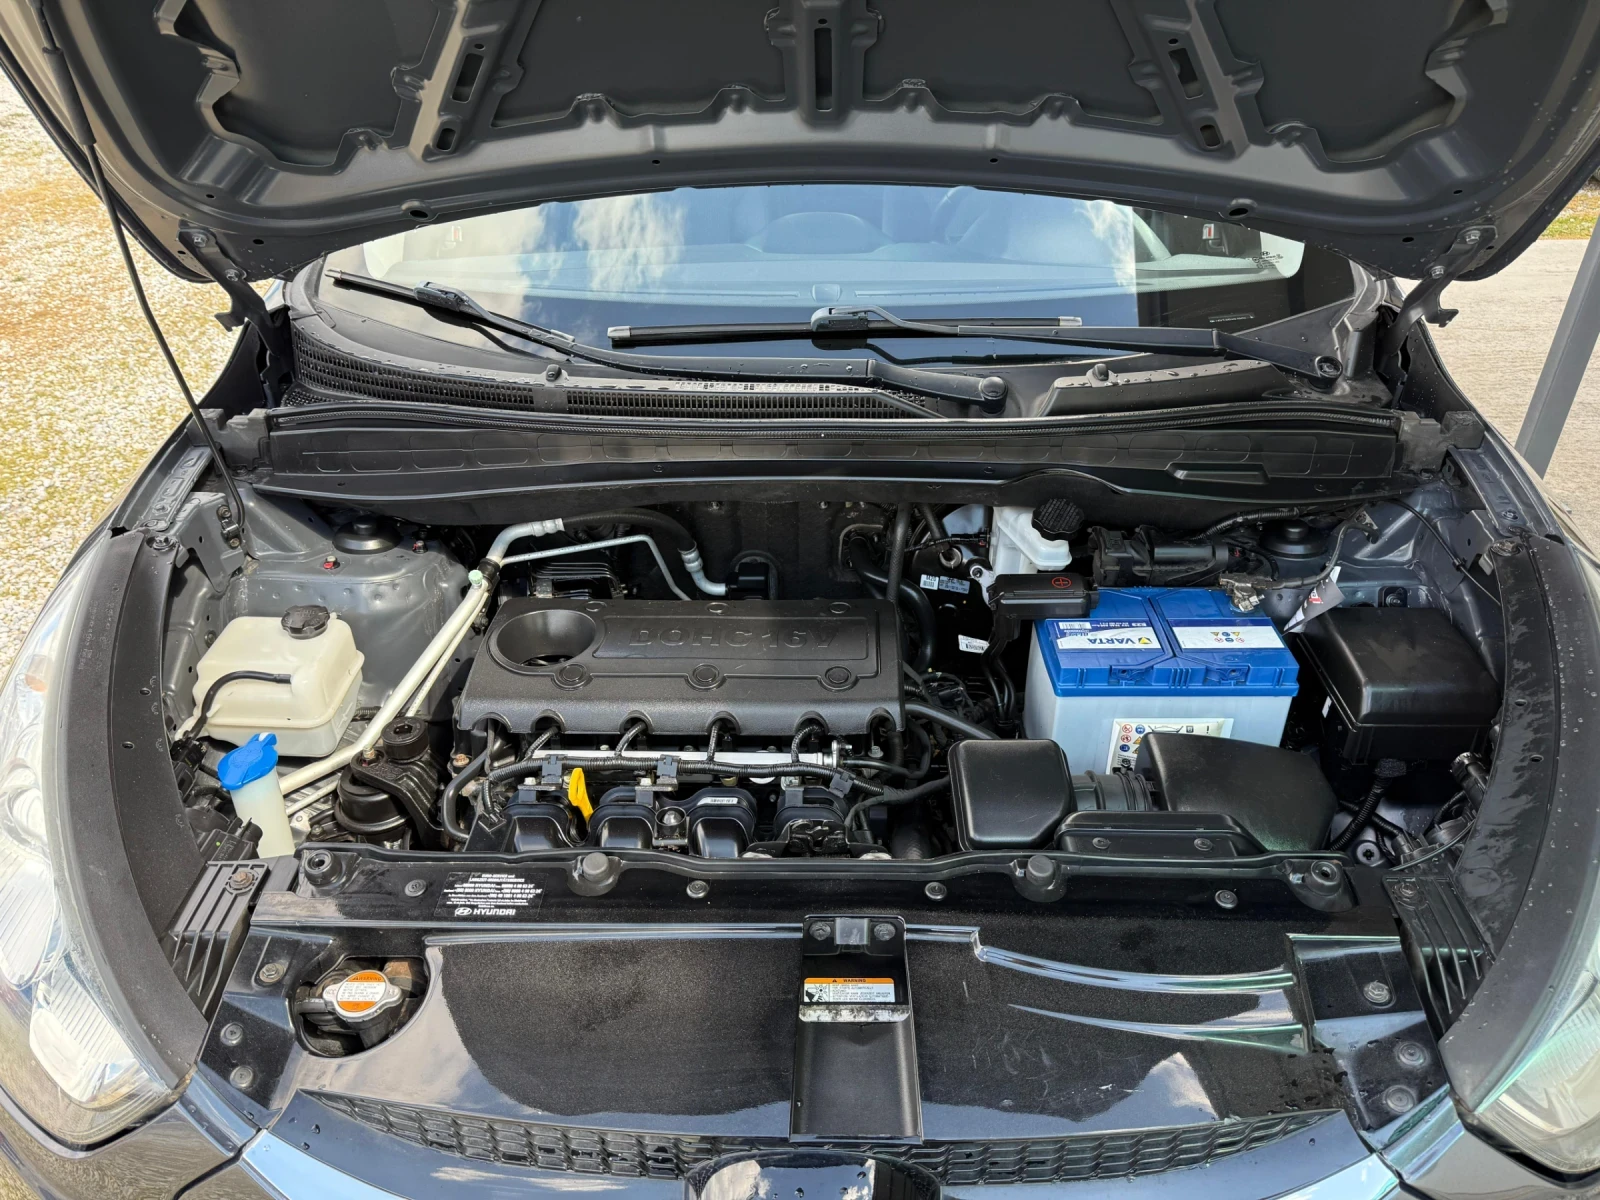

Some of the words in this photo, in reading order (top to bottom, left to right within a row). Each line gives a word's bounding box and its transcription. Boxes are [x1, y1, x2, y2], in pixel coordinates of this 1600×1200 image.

[629, 627, 753, 647] DOHC
[761, 628, 840, 649] 16V
[1087, 637, 1135, 645] VARTA
